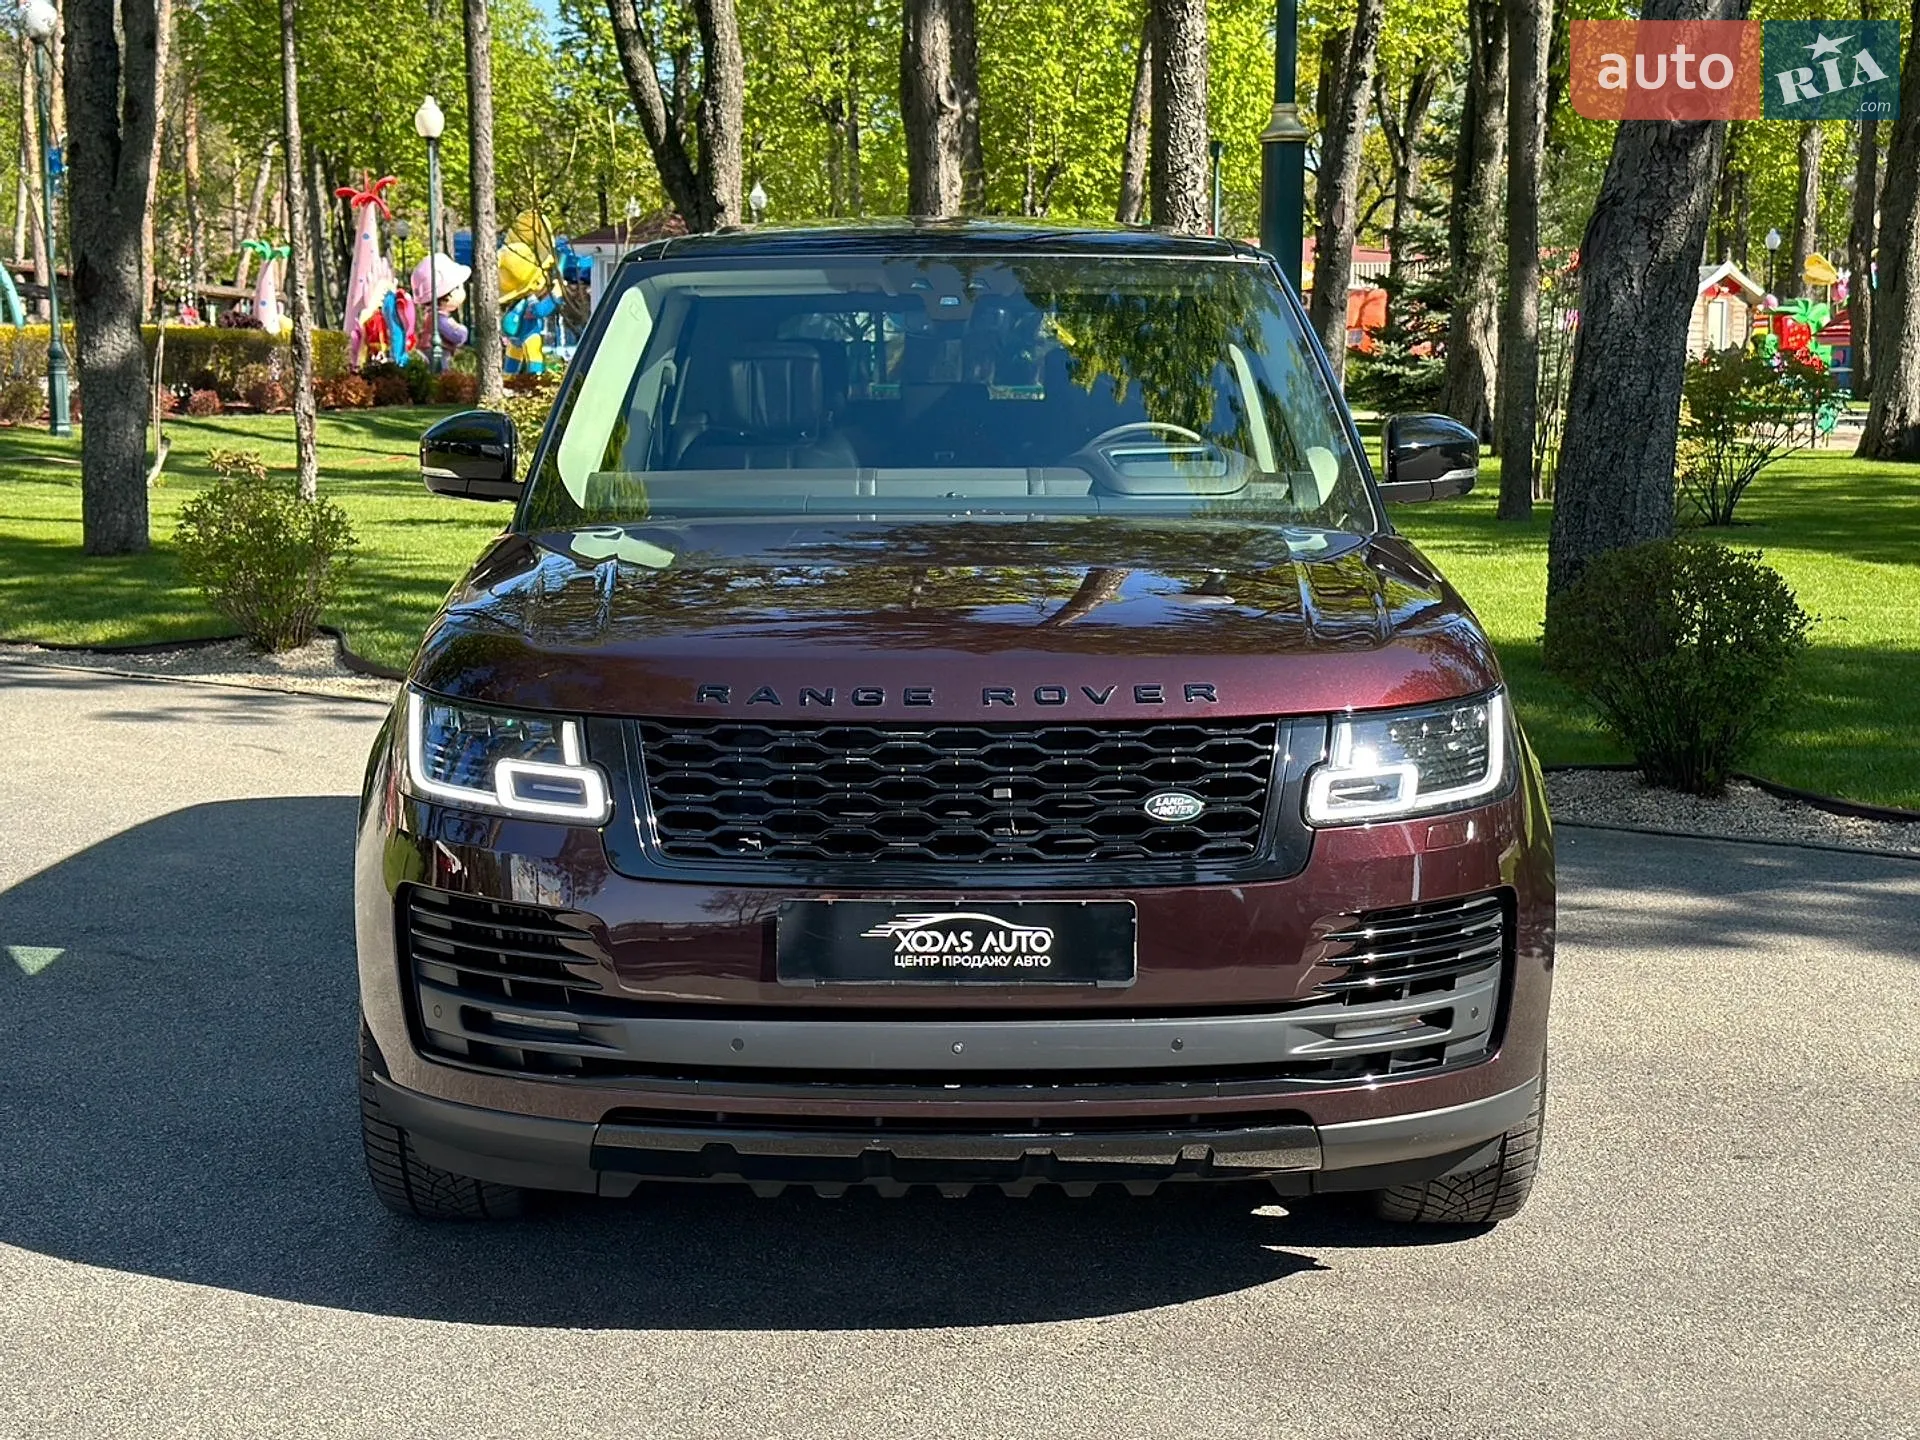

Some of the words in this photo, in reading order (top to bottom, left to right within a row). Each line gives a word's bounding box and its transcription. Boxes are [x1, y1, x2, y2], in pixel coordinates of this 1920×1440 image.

[696, 684, 935, 707] RANGE
[982, 683, 1218, 708] ROVER
[1155, 797, 1185, 807] LAND
[1158, 805, 1195, 815] ROVER
[894, 930, 974, 953] XODAS
[980, 930, 1052, 953] AUTO
[894, 955, 940, 969] ЦЕНТР
[942, 955, 1012, 969] ПРОДАЖУ
[1013, 955, 1052, 968] АВТО
